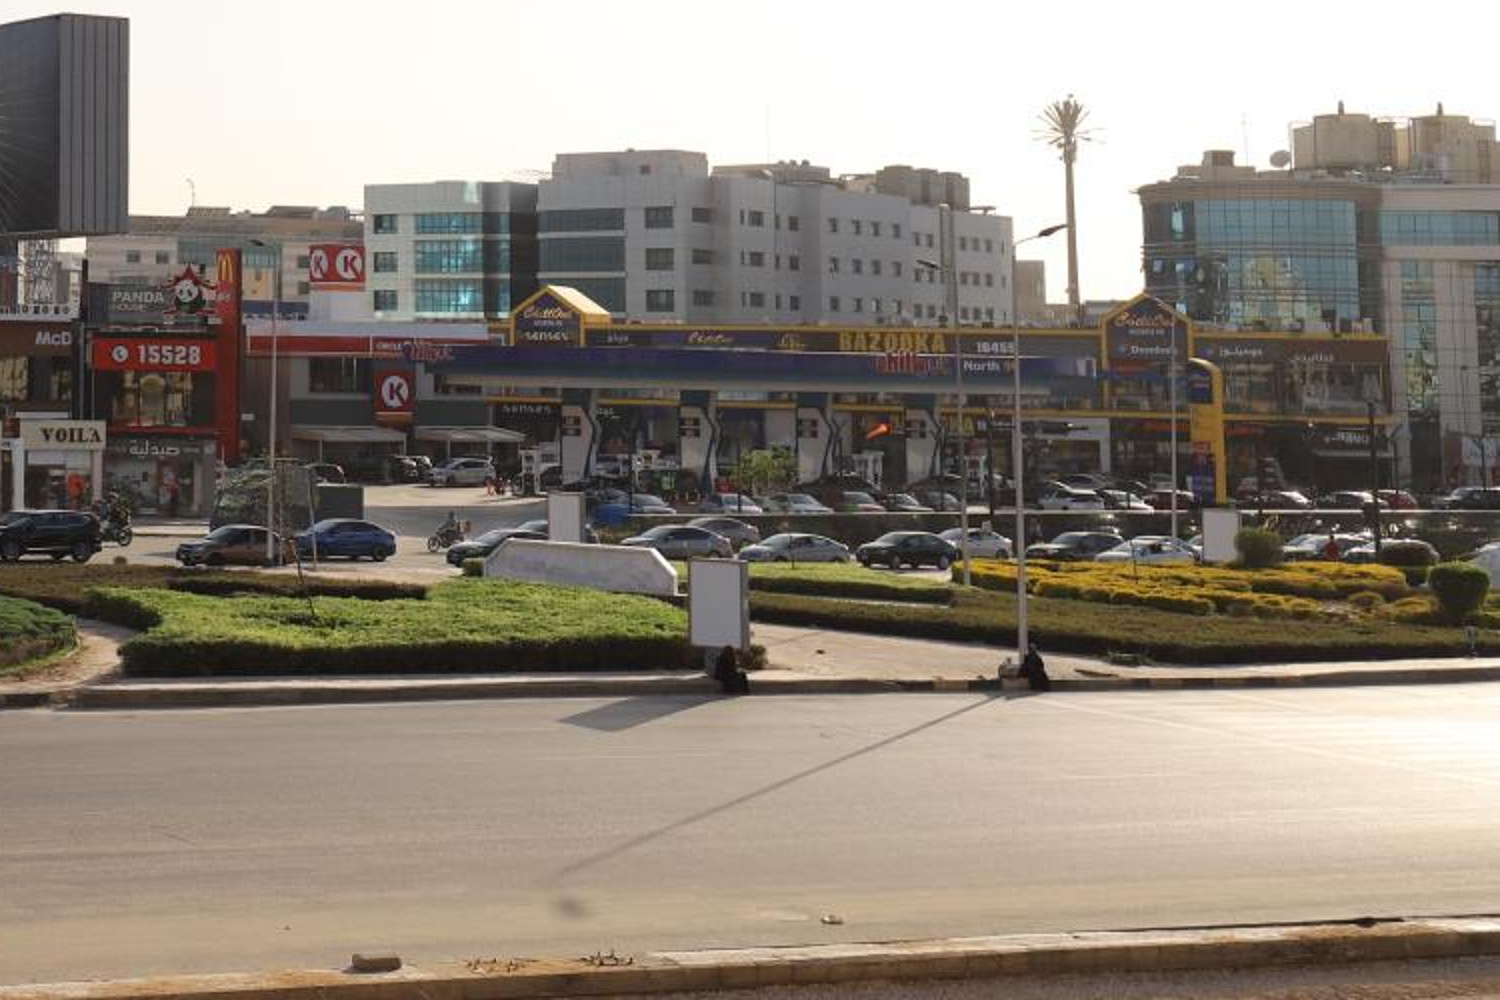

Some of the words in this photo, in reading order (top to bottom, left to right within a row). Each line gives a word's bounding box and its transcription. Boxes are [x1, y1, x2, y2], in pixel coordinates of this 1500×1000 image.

[112, 291, 165, 303] PANDA
[838, 331, 947, 352] BAZOOKA
[137, 345, 201, 365] 15528
[963, 360, 1000, 371] North
[129, 439, 181, 460] صيدلية
